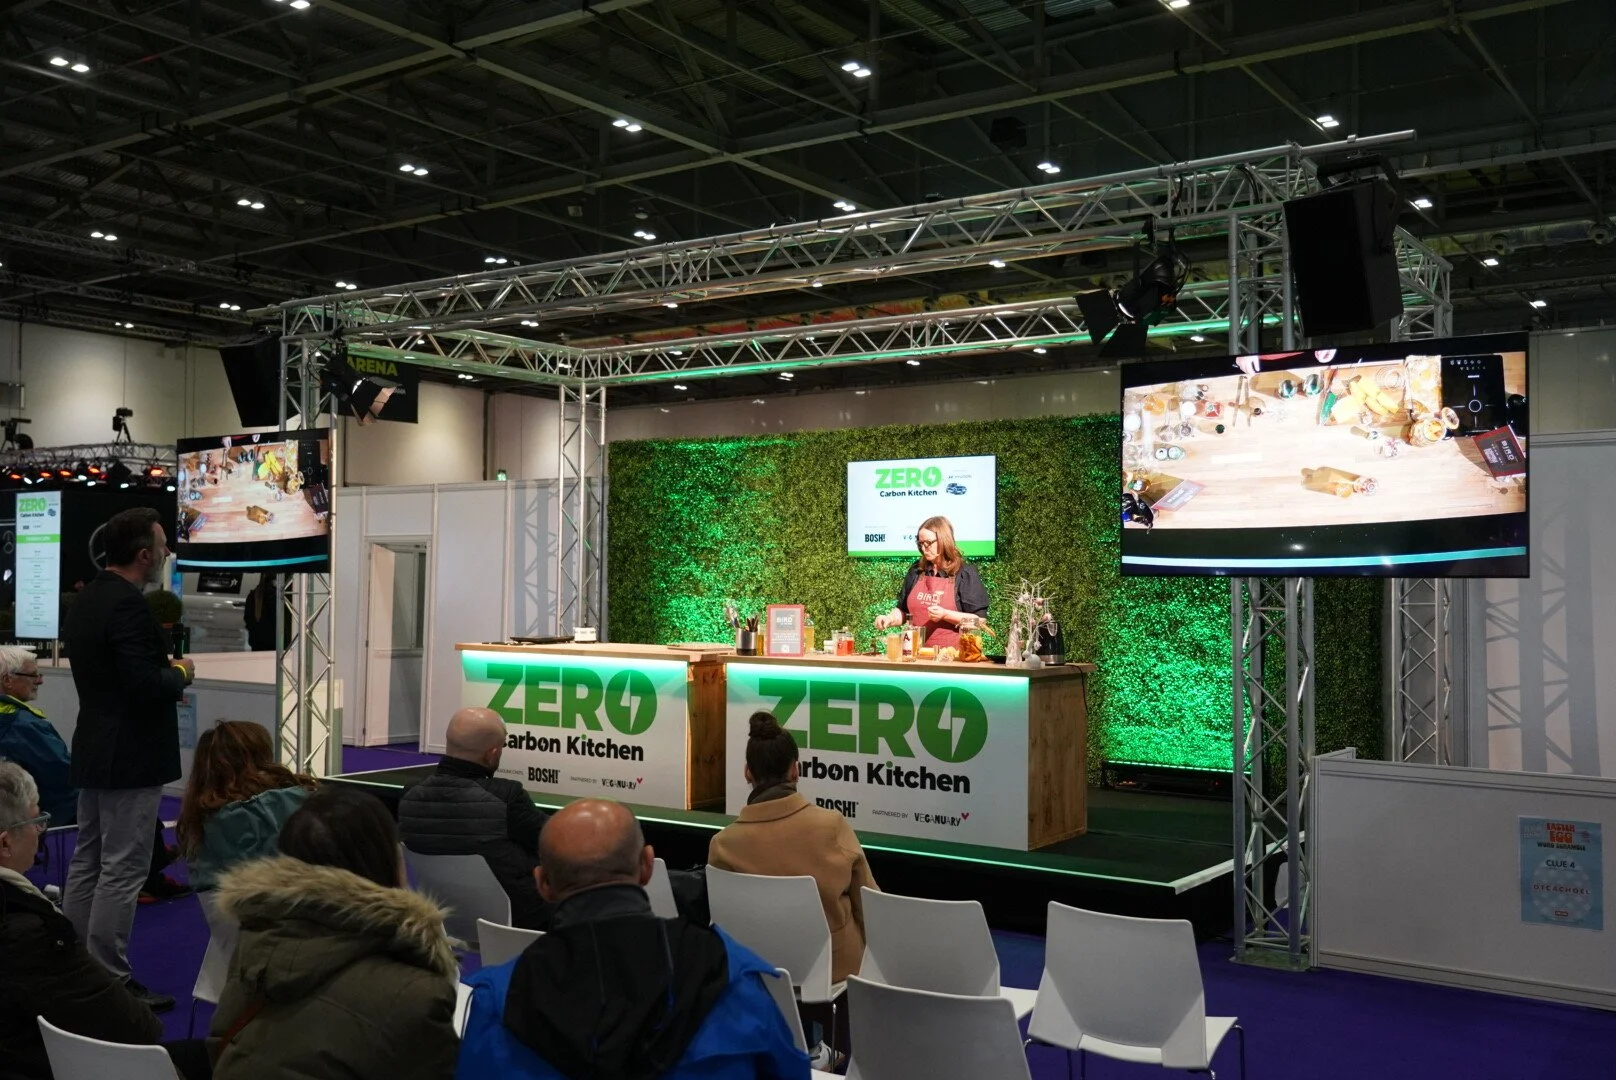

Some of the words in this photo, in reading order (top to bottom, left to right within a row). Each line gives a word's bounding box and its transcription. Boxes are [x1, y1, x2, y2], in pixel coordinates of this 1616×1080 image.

[347, 356, 398, 376] ARENA
[875, 466, 942, 489] ZERO
[907, 489, 938, 497] Kitchen
[19, 497, 46, 512] ZERO
[864, 533, 886, 543] BOSH!
[487, 663, 657, 735] ZERO
[758, 677, 988, 763] ZERO
[503, 731, 561, 754] arbon
[566, 733, 644, 762] Kitchen
[528, 766, 558, 784] BOSH!
[866, 760, 971, 794] Kitchen
[872, 809, 901, 819] PARTNERED
[914, 812, 961, 827] VEGANUARY
[1546, 859, 1568, 868] CLUE
